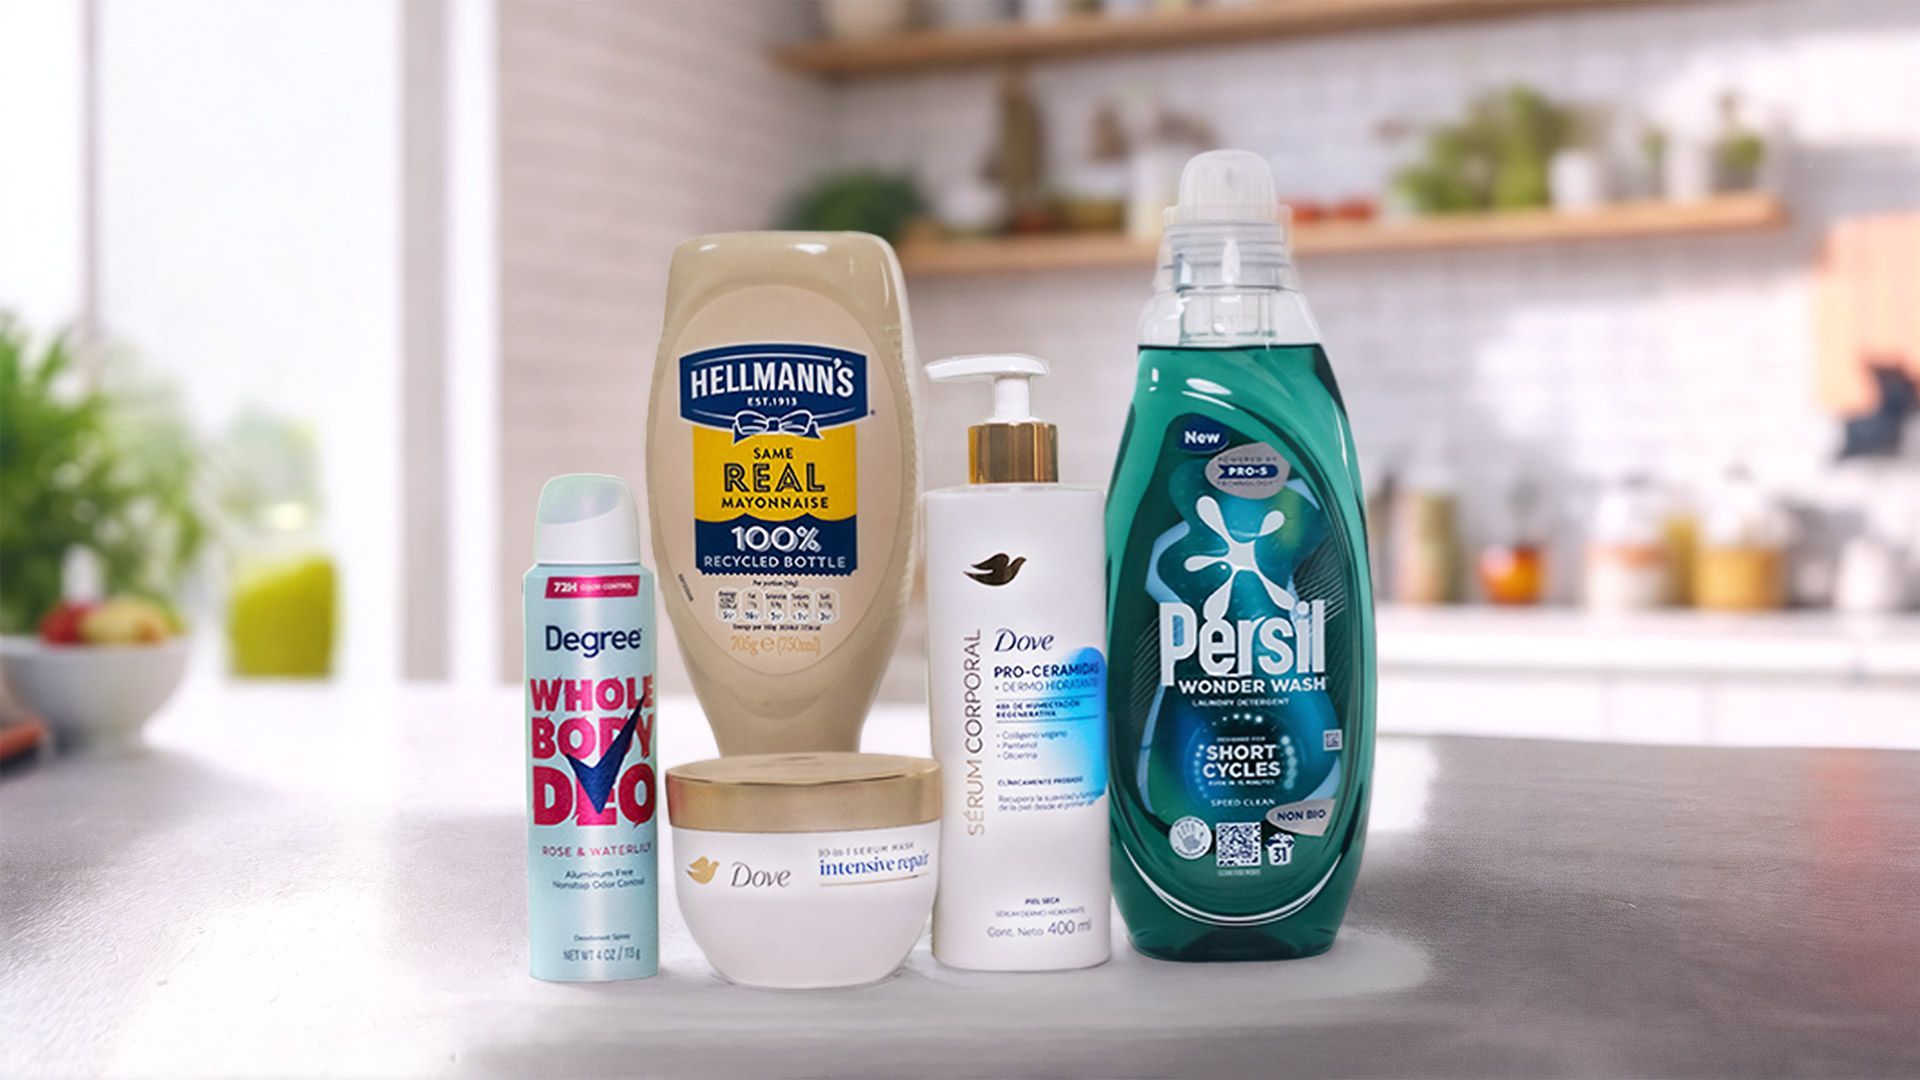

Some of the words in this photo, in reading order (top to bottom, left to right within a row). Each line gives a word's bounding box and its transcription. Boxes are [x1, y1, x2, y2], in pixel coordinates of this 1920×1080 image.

[691, 358, 854, 400] HELLMANN'S
[1184, 431, 1220, 444] New
[754, 447, 794, 459] SAME
[724, 463, 825, 492] REAL
[1228, 466, 1268, 477] PRO-S
[721, 496, 829, 509] MAYONNAISE
[731, 525, 822, 552] 100%
[704, 555, 780, 568] RECYCLED
[784, 555, 846, 568] BOTTLE
[553, 581, 578, 593] 72H
[545, 625, 641, 658] Degree
[994, 627, 1055, 652] Dove
[1159, 598, 1326, 686] Persil
[994, 661, 1099, 678] PRO-CERAMIDAS
[530, 674, 653, 712] WHOLE
[964, 629, 982, 754] CORPORAL
[1002, 680, 1043, 692] DERMO
[1178, 680, 1266, 695] WONDER
[1270, 677, 1327, 692] WASH
[1206, 744, 1277, 761] SHORT
[1202, 761, 1281, 778] CYCLES
[964, 759, 985, 836] SÉRUM
[1210, 799, 1241, 807] SPEED
[1243, 798, 1276, 807] CLEAN
[1277, 810, 1303, 821] NON
[1306, 809, 1326, 820] BIO
[542, 845, 572, 857] ROSE
[576, 846, 586, 857] &
[1272, 847, 1287, 863] 31
[731, 860, 792, 888] Dove
[820, 856, 896, 876] intensive
[1047, 920, 1075, 935] 400
